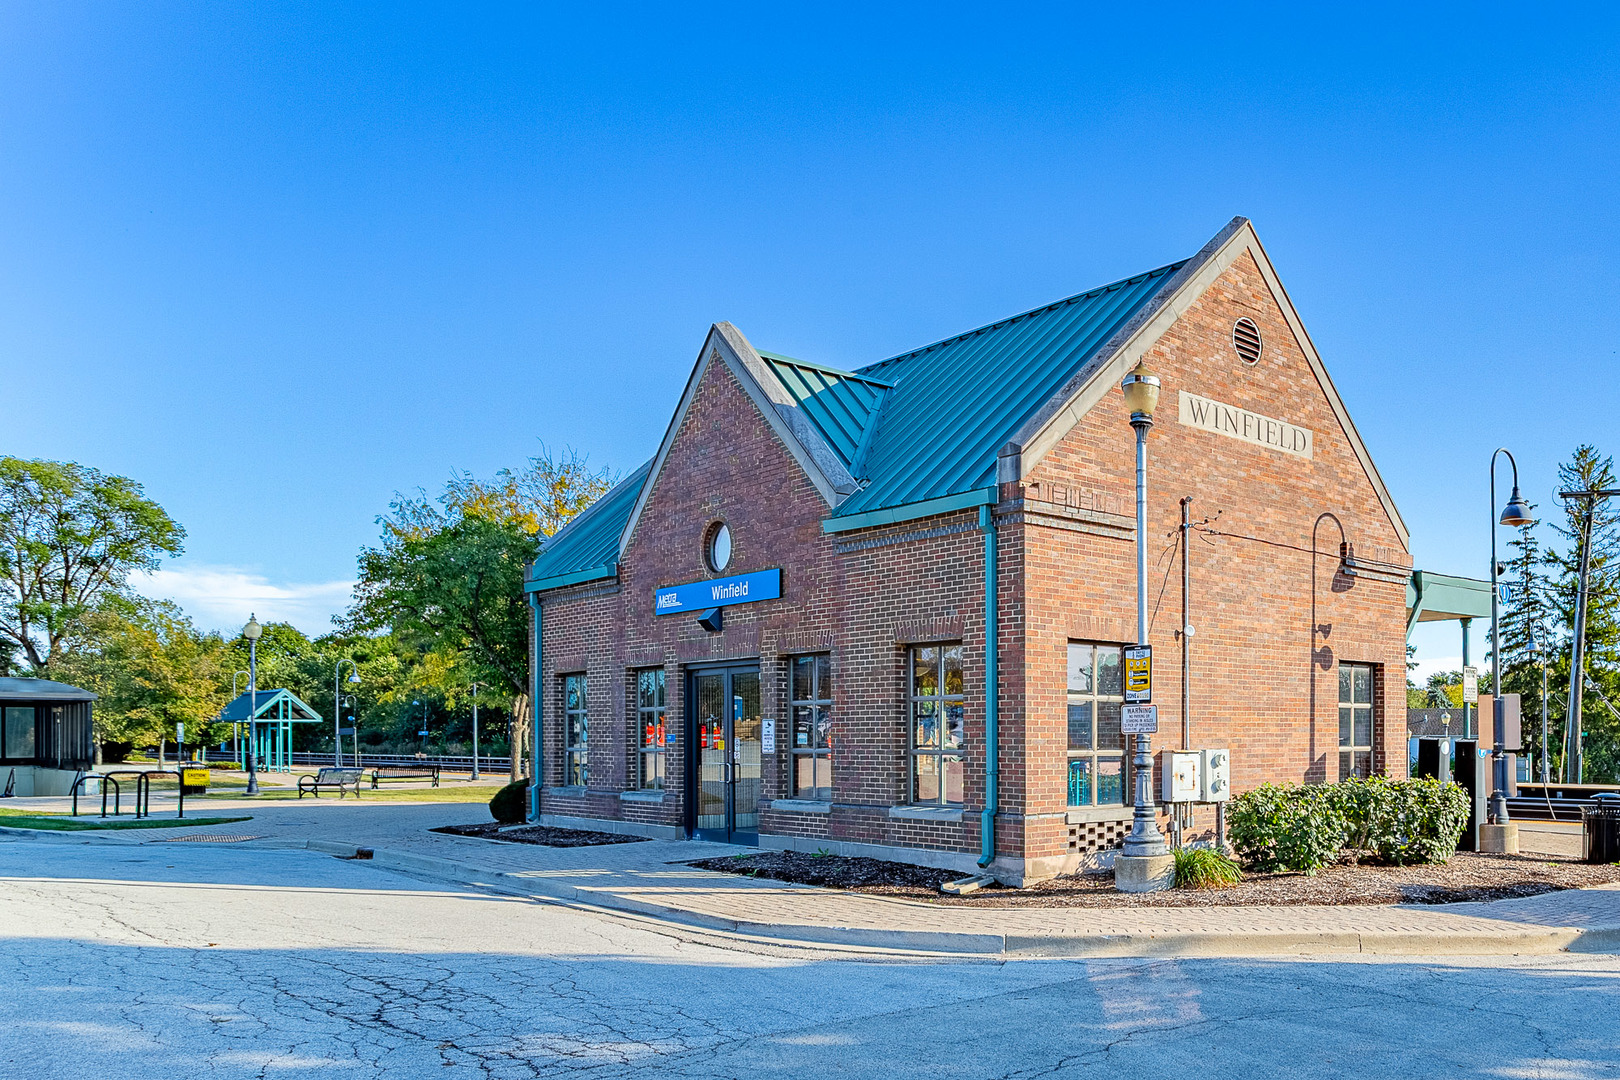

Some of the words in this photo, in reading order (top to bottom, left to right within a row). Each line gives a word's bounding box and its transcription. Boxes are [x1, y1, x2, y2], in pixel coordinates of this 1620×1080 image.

[1187, 396, 1307, 453] WINFIELD
[656, 592, 682, 609] Metra
[711, 580, 749, 601] Winfield
